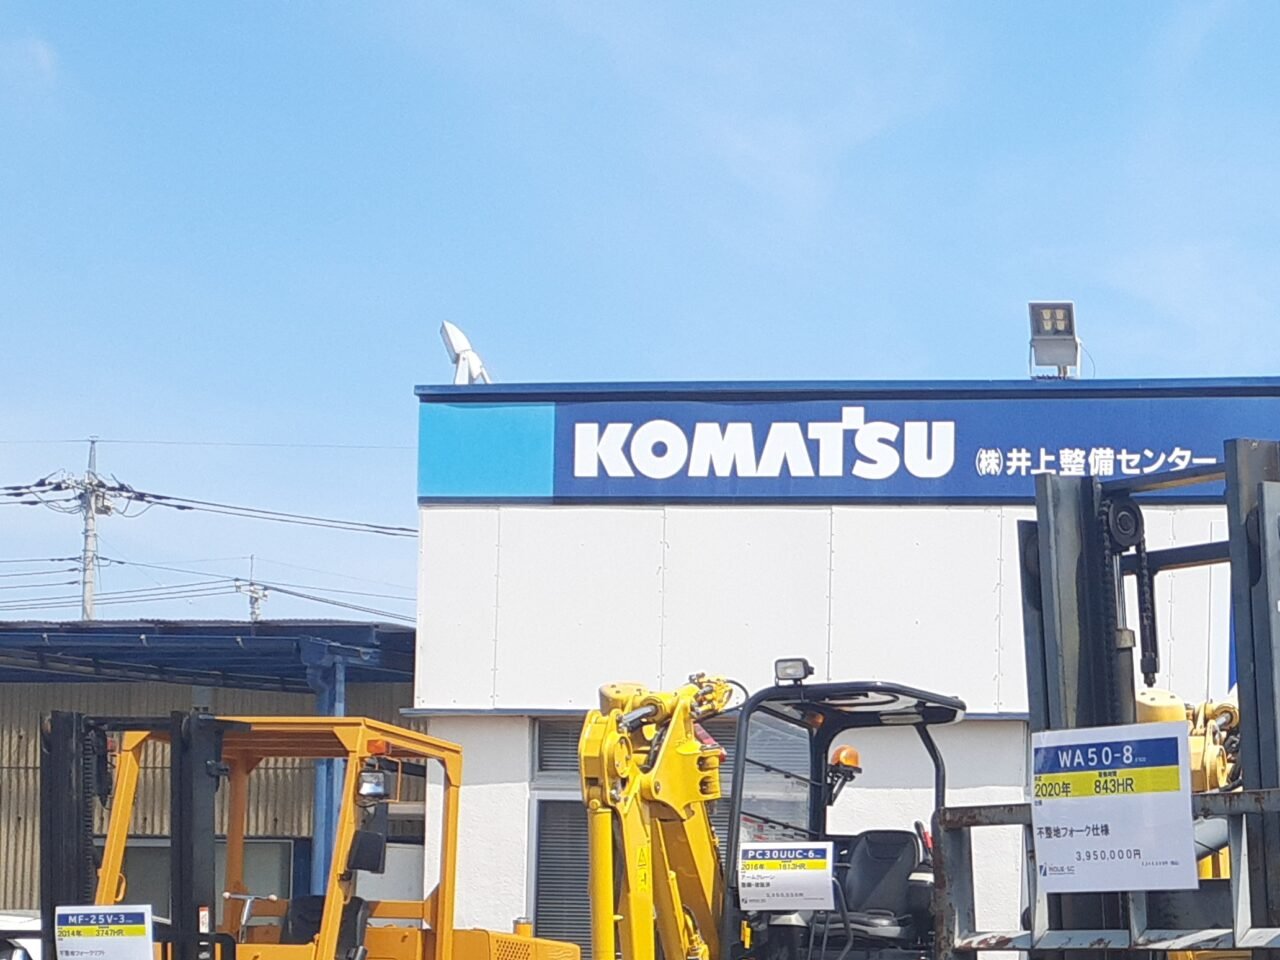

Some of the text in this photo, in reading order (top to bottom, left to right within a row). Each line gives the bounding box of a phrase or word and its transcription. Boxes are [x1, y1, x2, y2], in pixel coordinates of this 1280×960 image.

[574, 406, 955, 479] KOMATSU
[1058, 745, 1133, 768] WA50-8
[1034, 777, 1134, 798] 2020年 843HR
[1036, 823, 1110, 839] 不整地フォーク仕様
[748, 850, 814, 859] PC30UUC-6
[1075, 849, 1142, 861] 3,950,000円
[68, 915, 125, 924] MF-25V-3
